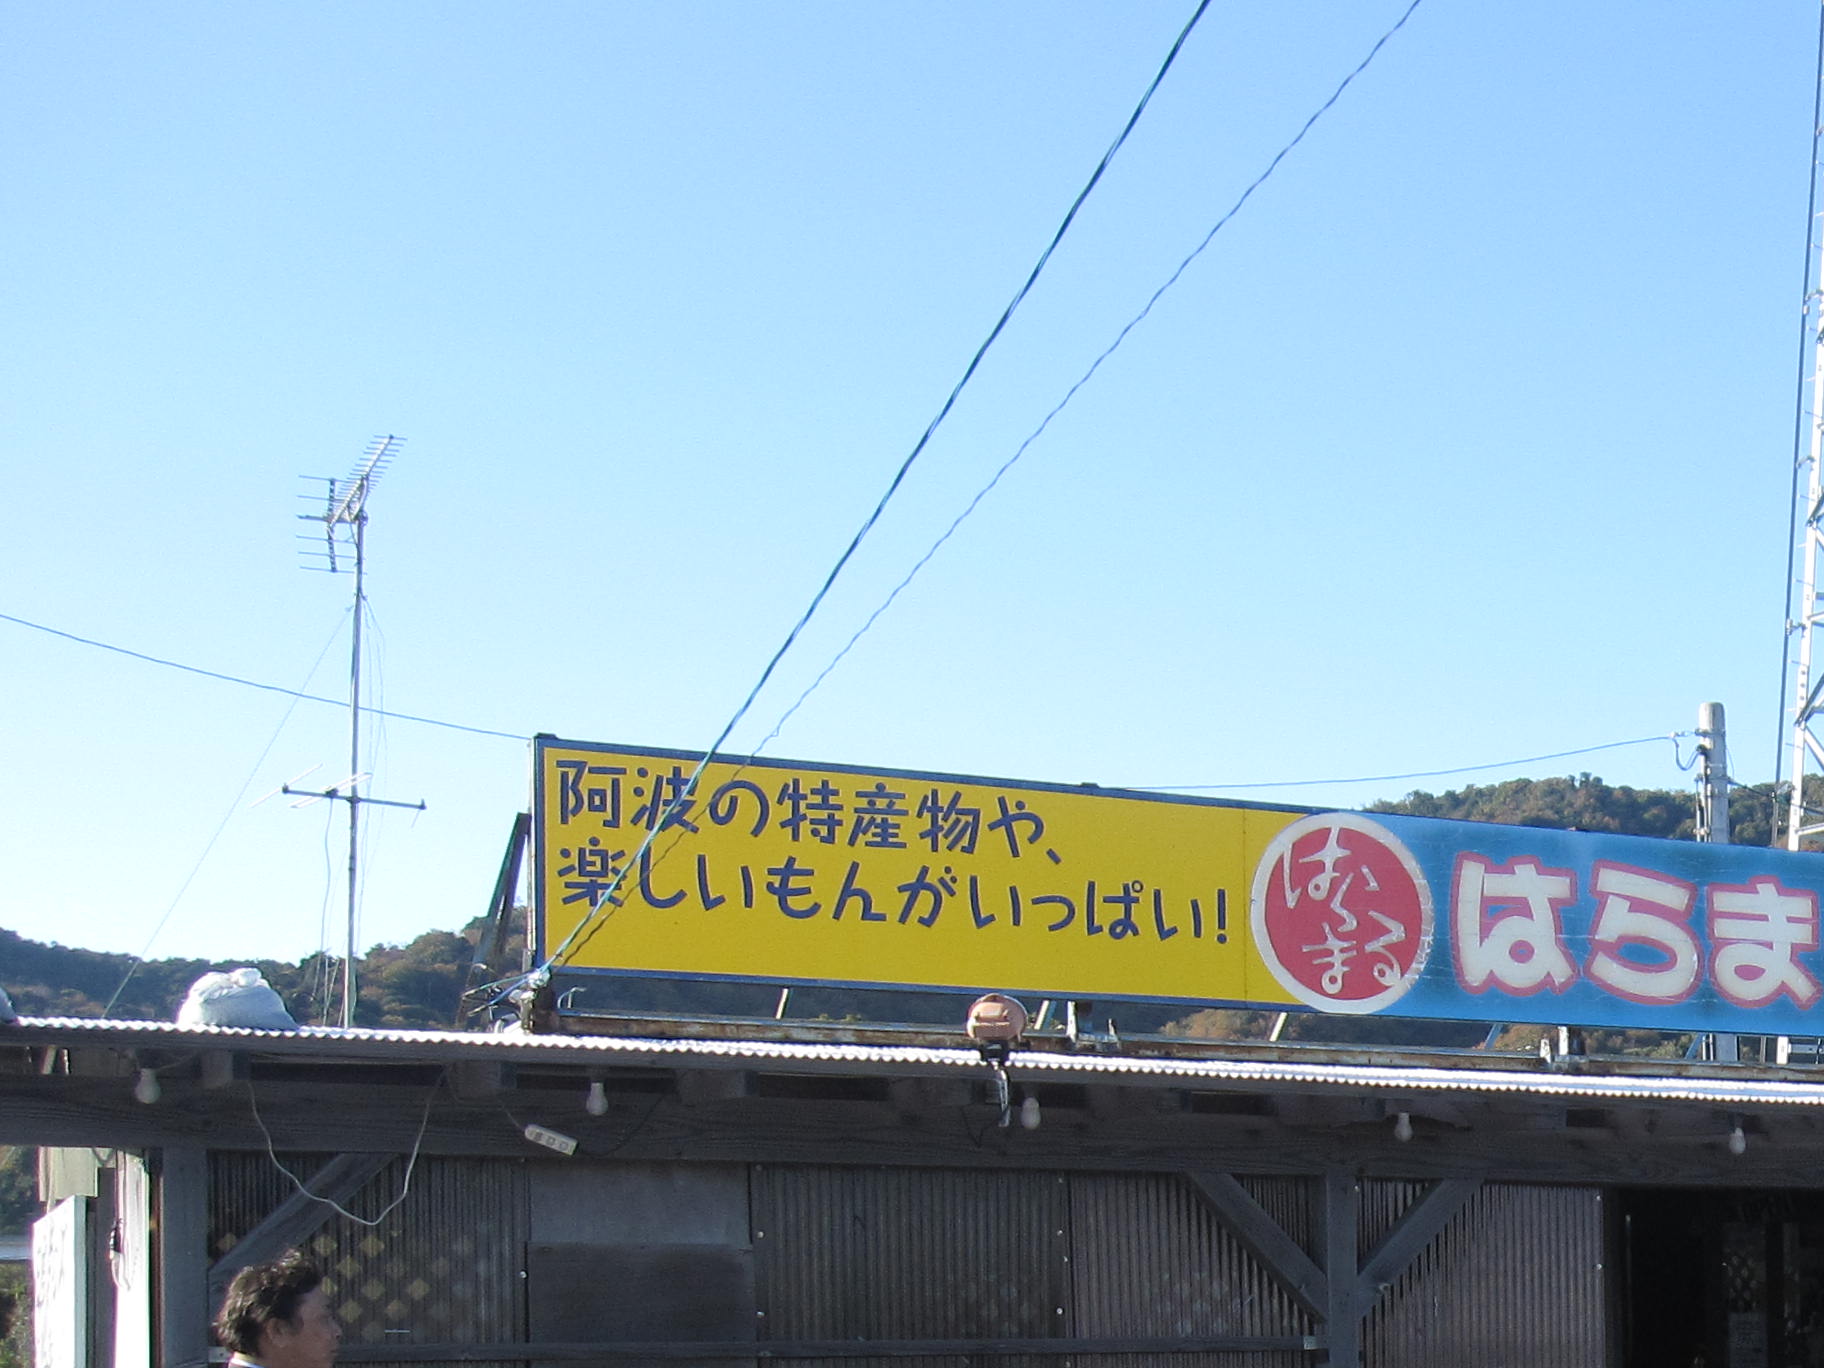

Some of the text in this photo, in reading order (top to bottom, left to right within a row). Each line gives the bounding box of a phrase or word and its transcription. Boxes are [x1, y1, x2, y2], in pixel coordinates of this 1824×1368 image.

[555, 759, 1063, 865] 阿波の特産物や、
[556, 837, 1229, 944] 楽しいもんがいっぱい!
